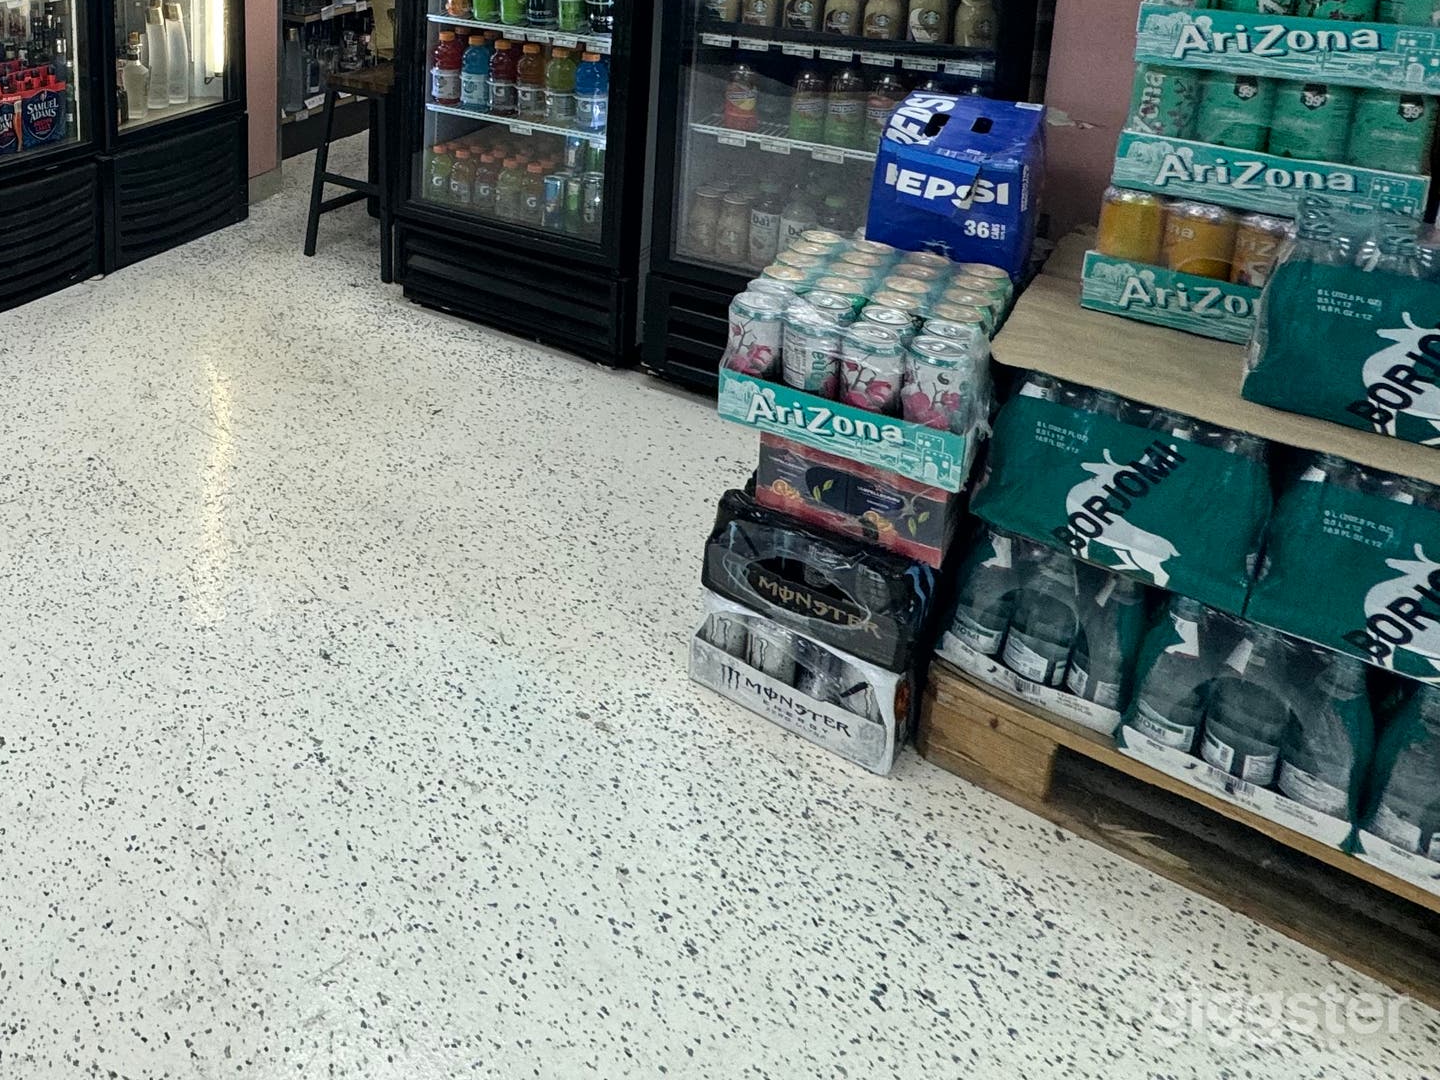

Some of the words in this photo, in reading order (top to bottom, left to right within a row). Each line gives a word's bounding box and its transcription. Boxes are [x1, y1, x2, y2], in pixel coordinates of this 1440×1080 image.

[1172, 23, 1383, 60] AriZona
[27, 97, 59, 115] SAMUEL
[30, 108, 57, 124] ADAMS
[1154, 152, 1358, 193] AriZona
[963, 219, 990, 239] 36
[745, 393, 906, 444] AriZona
[1052, 439, 1188, 557] BORJOMI
[758, 574, 883, 640] MONSTER
[745, 677, 852, 738] MONSTER
